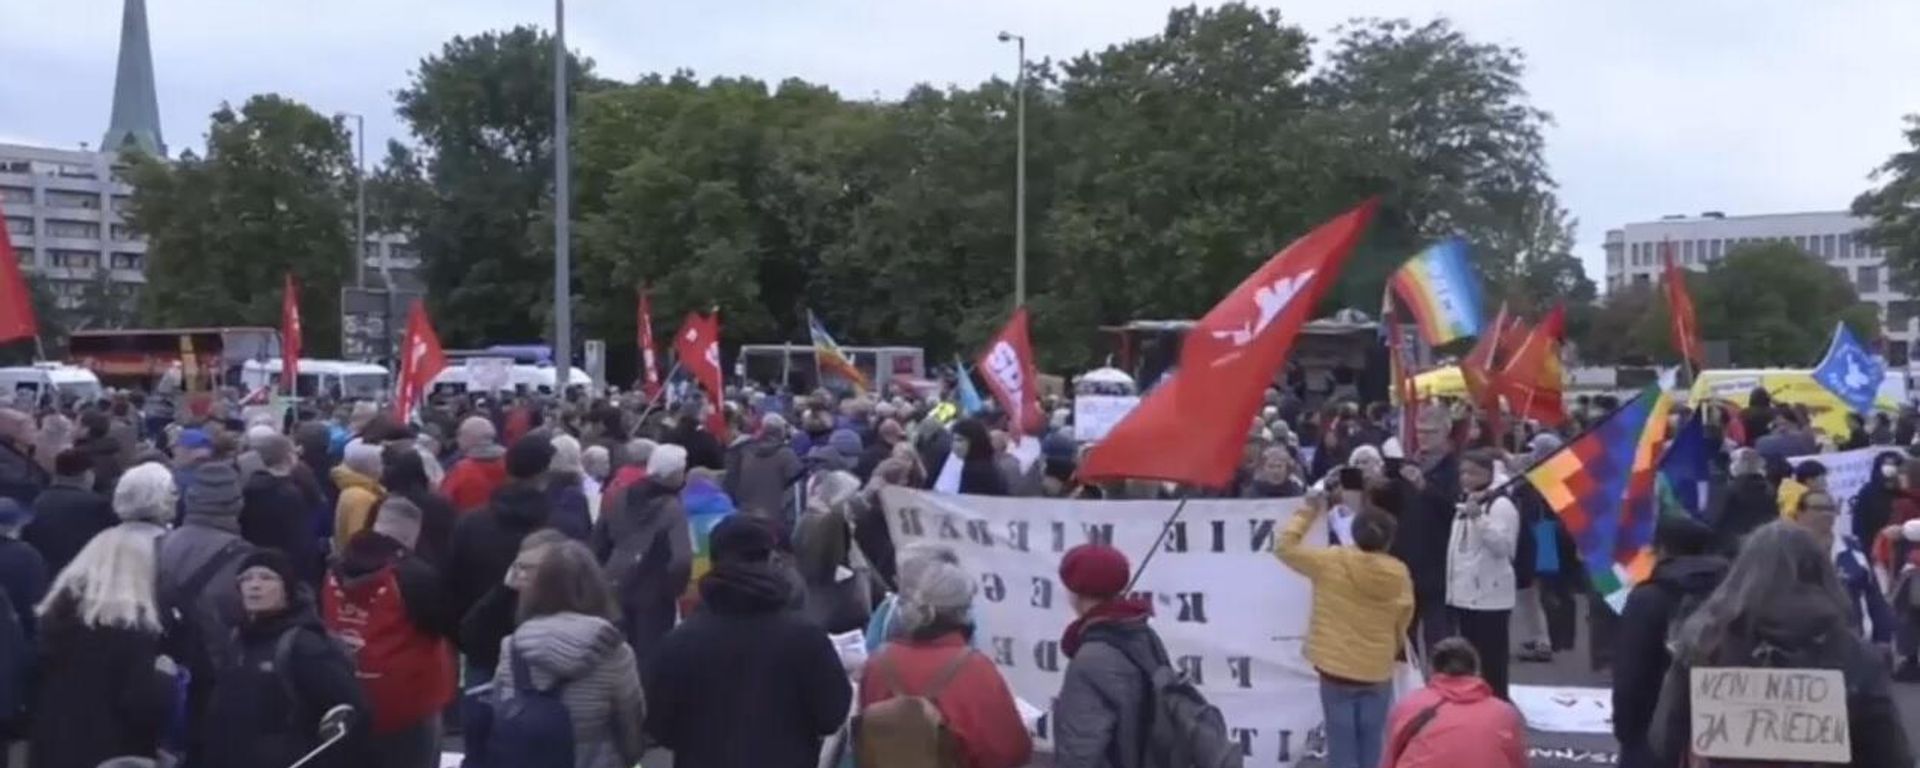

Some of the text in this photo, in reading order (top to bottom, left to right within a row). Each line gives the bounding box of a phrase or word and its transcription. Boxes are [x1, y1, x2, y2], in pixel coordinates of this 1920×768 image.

[1764, 672, 1829, 703] NATO
[1695, 707, 1847, 751] JA FRIEDEN
